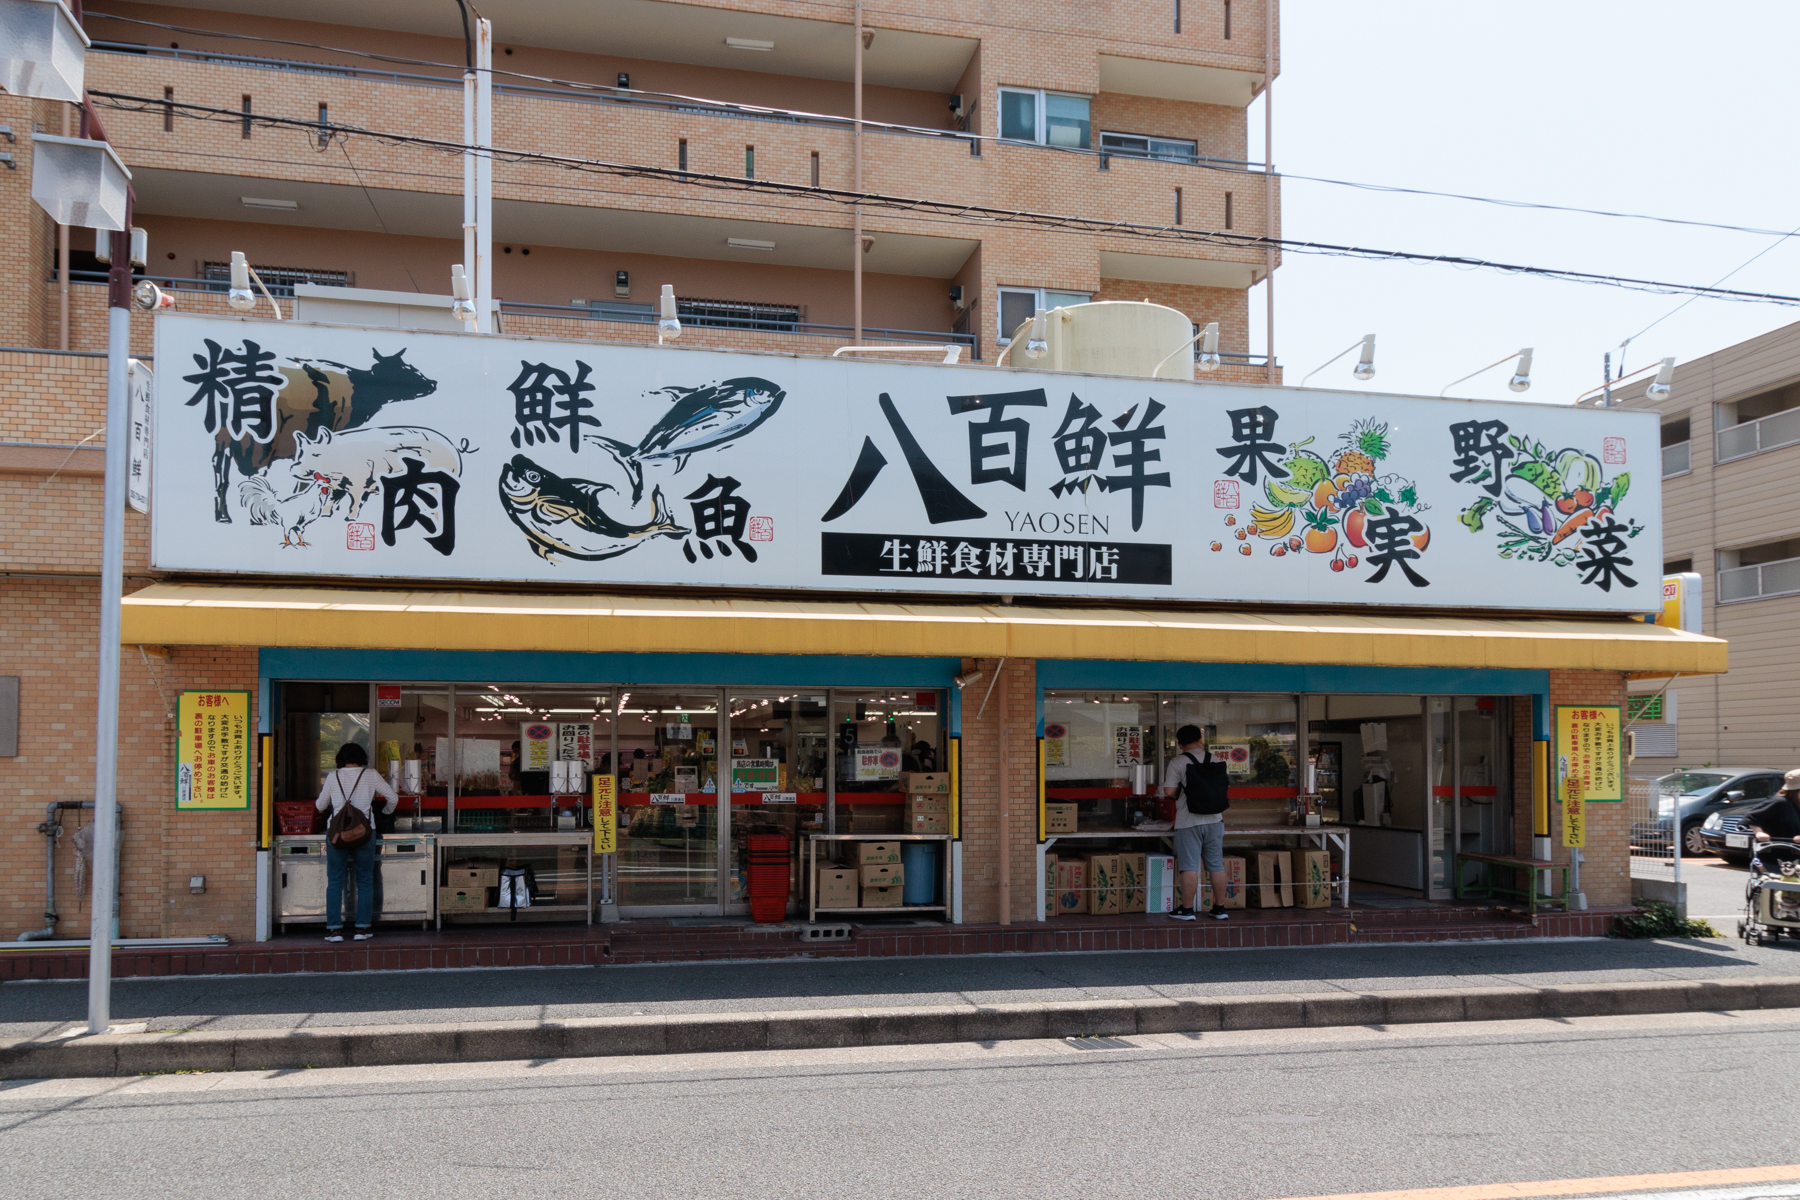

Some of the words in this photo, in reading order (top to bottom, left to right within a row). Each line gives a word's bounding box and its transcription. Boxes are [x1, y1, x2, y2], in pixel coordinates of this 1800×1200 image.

[184, 338, 280, 440] 精
[380, 458, 461, 556] 肉
[506, 359, 602, 453] 鮮
[682, 474, 758, 564] 魚
[821, 387, 1171, 533] 八百鮮
[1004, 510, 1110, 536] YAOSEN
[1216, 405, 1288, 485] 果
[1364, 510, 1431, 588] 実
[1449, 419, 1510, 497] 野
[1576, 517, 1639, 592] 菜
[879, 538, 1121, 580] 生鮮食材専門店
[197, 694, 229, 707] お客様へ
[844, 728, 855, 744] 5
[1571, 710, 1606, 720] お客様へ
[1627, 694, 1663, 721] 空車
[193, 713, 204, 803] 裏の駐車場へお停め下さい。
[206, 715, 216, 799] なりますのでお車のお客様は
[220, 714, 229, 799] 大変お手数ですが交通の妨げに
[562, 724, 576, 761] お回りくださ
[598, 777, 611, 850] 足元に注意して下さい
[1566, 778, 1581, 845] 足元に注意して下さい
